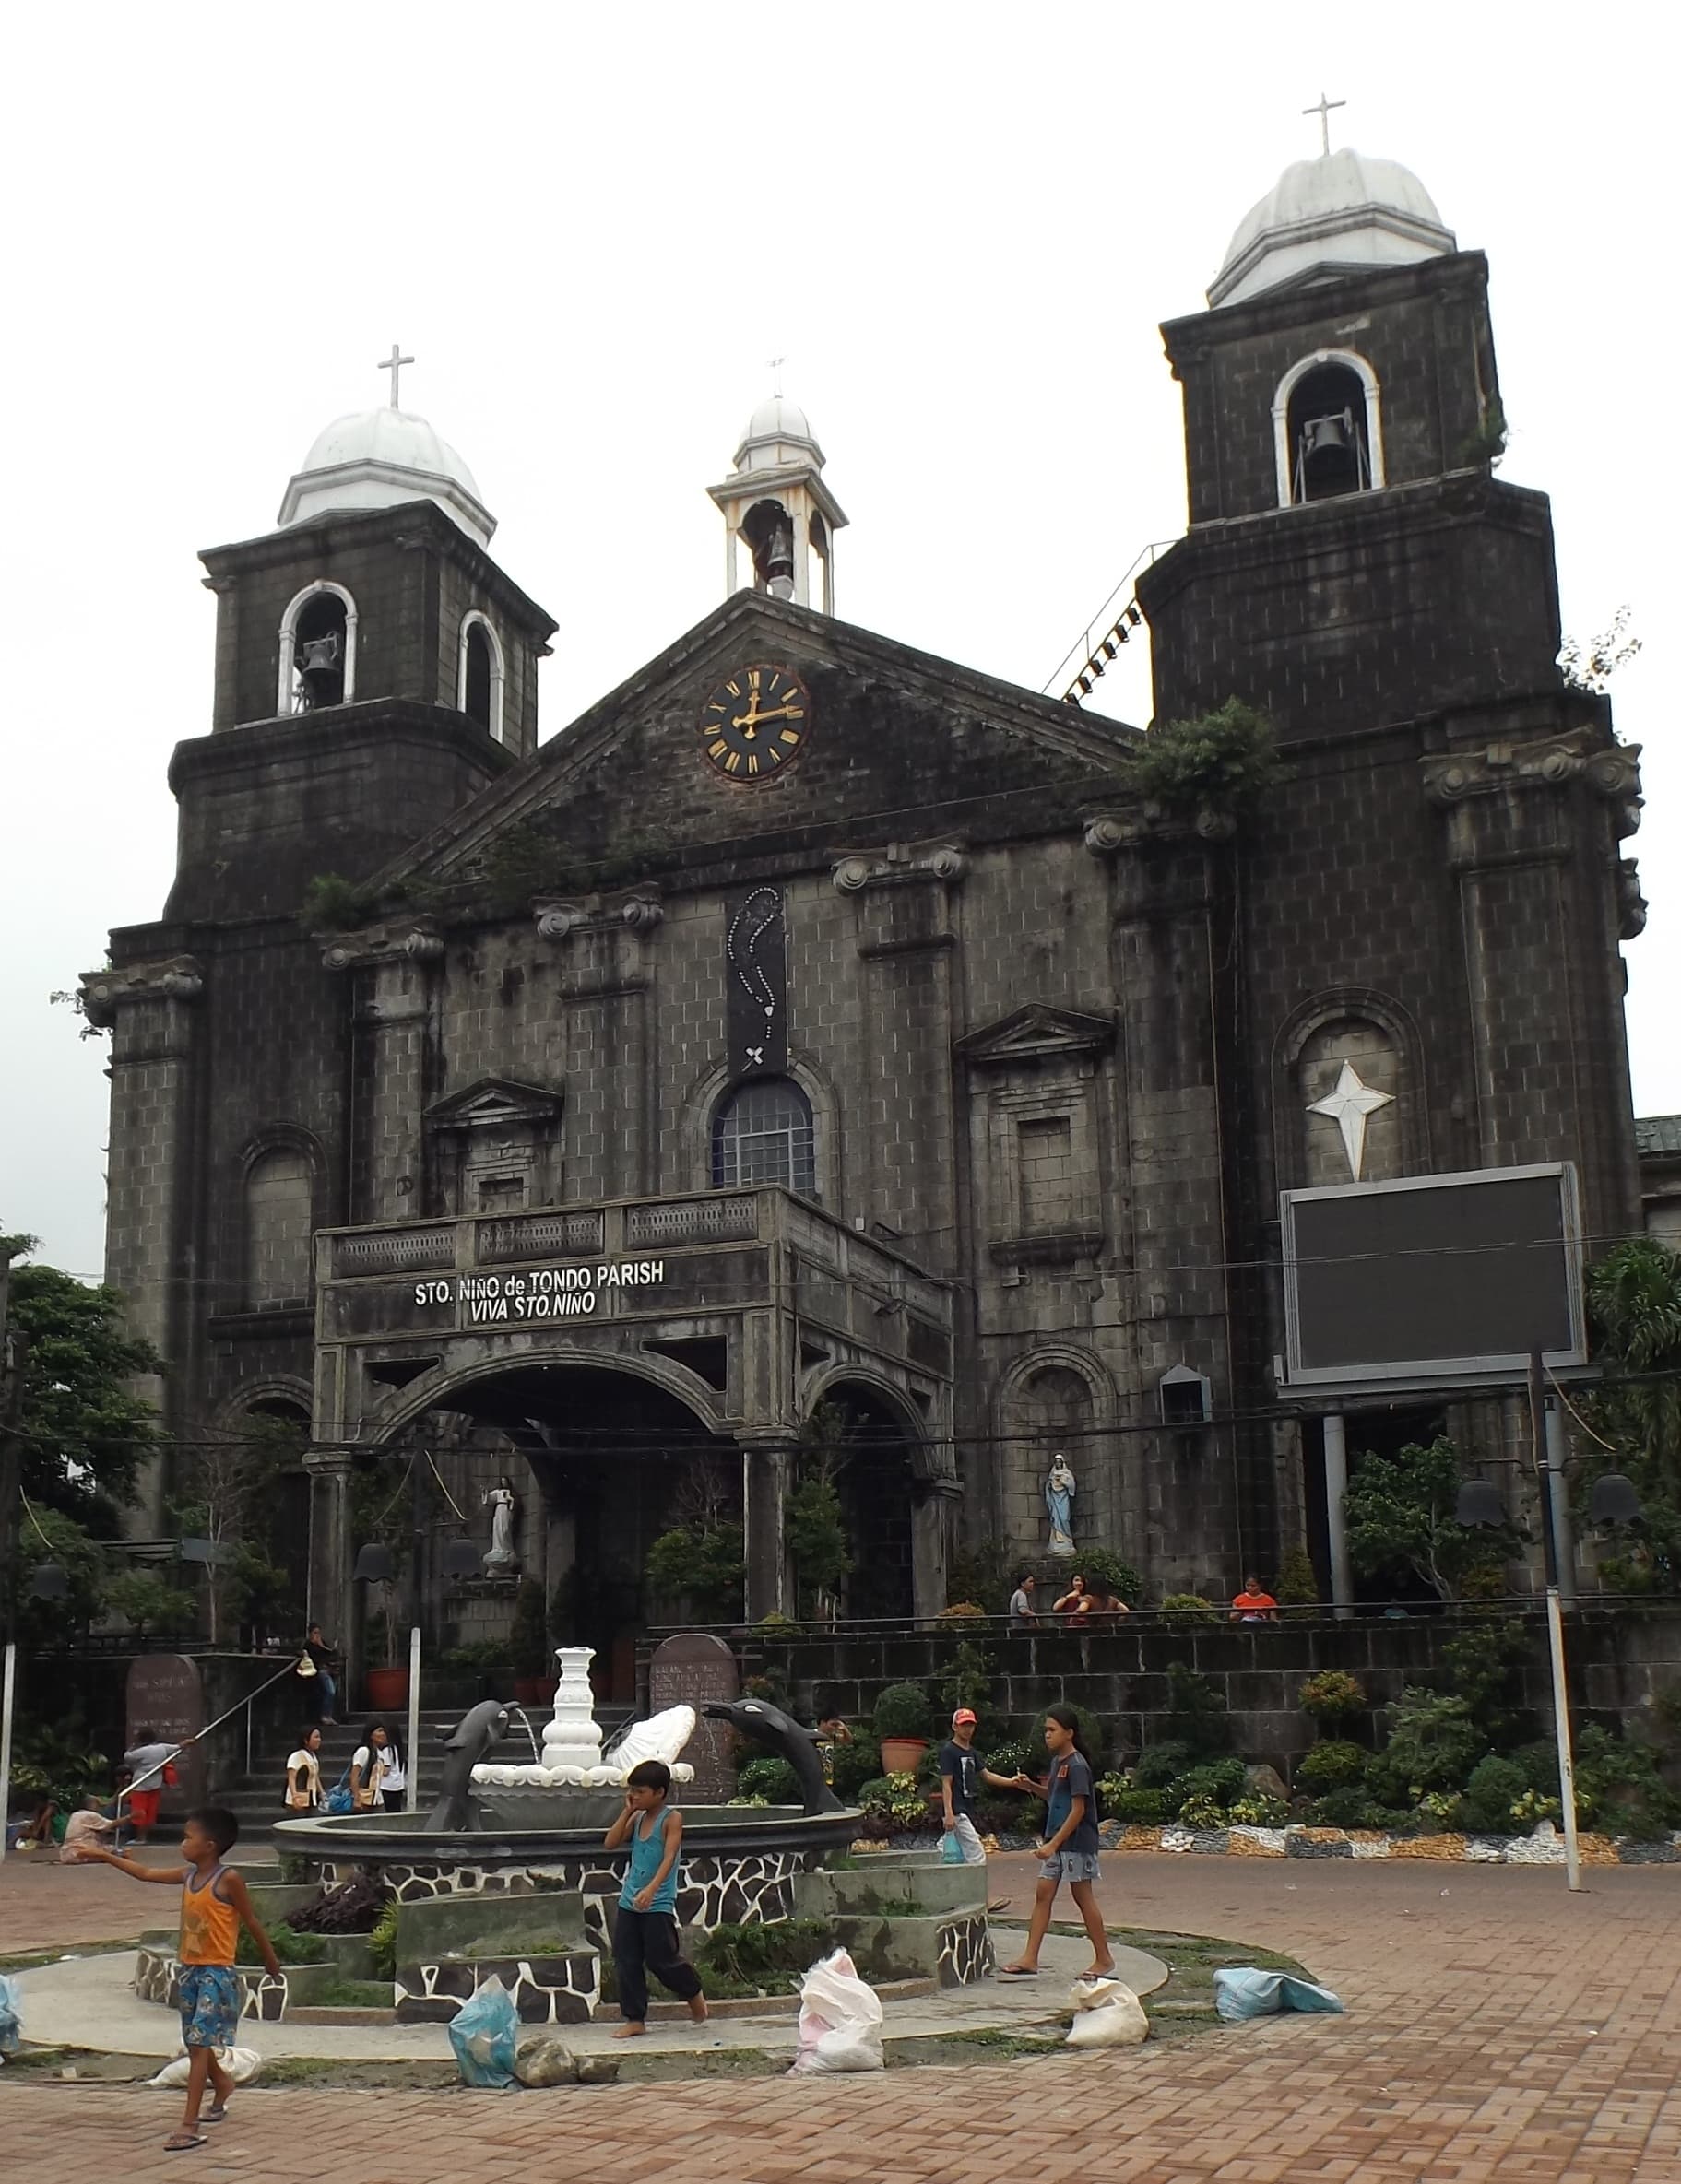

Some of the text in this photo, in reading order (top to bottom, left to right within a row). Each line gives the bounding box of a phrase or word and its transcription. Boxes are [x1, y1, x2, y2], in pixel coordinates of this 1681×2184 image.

[415, 1261, 663, 1305] STO. NIÑO de TONDO PARISH
[470, 1298, 508, 1321] VIVA
